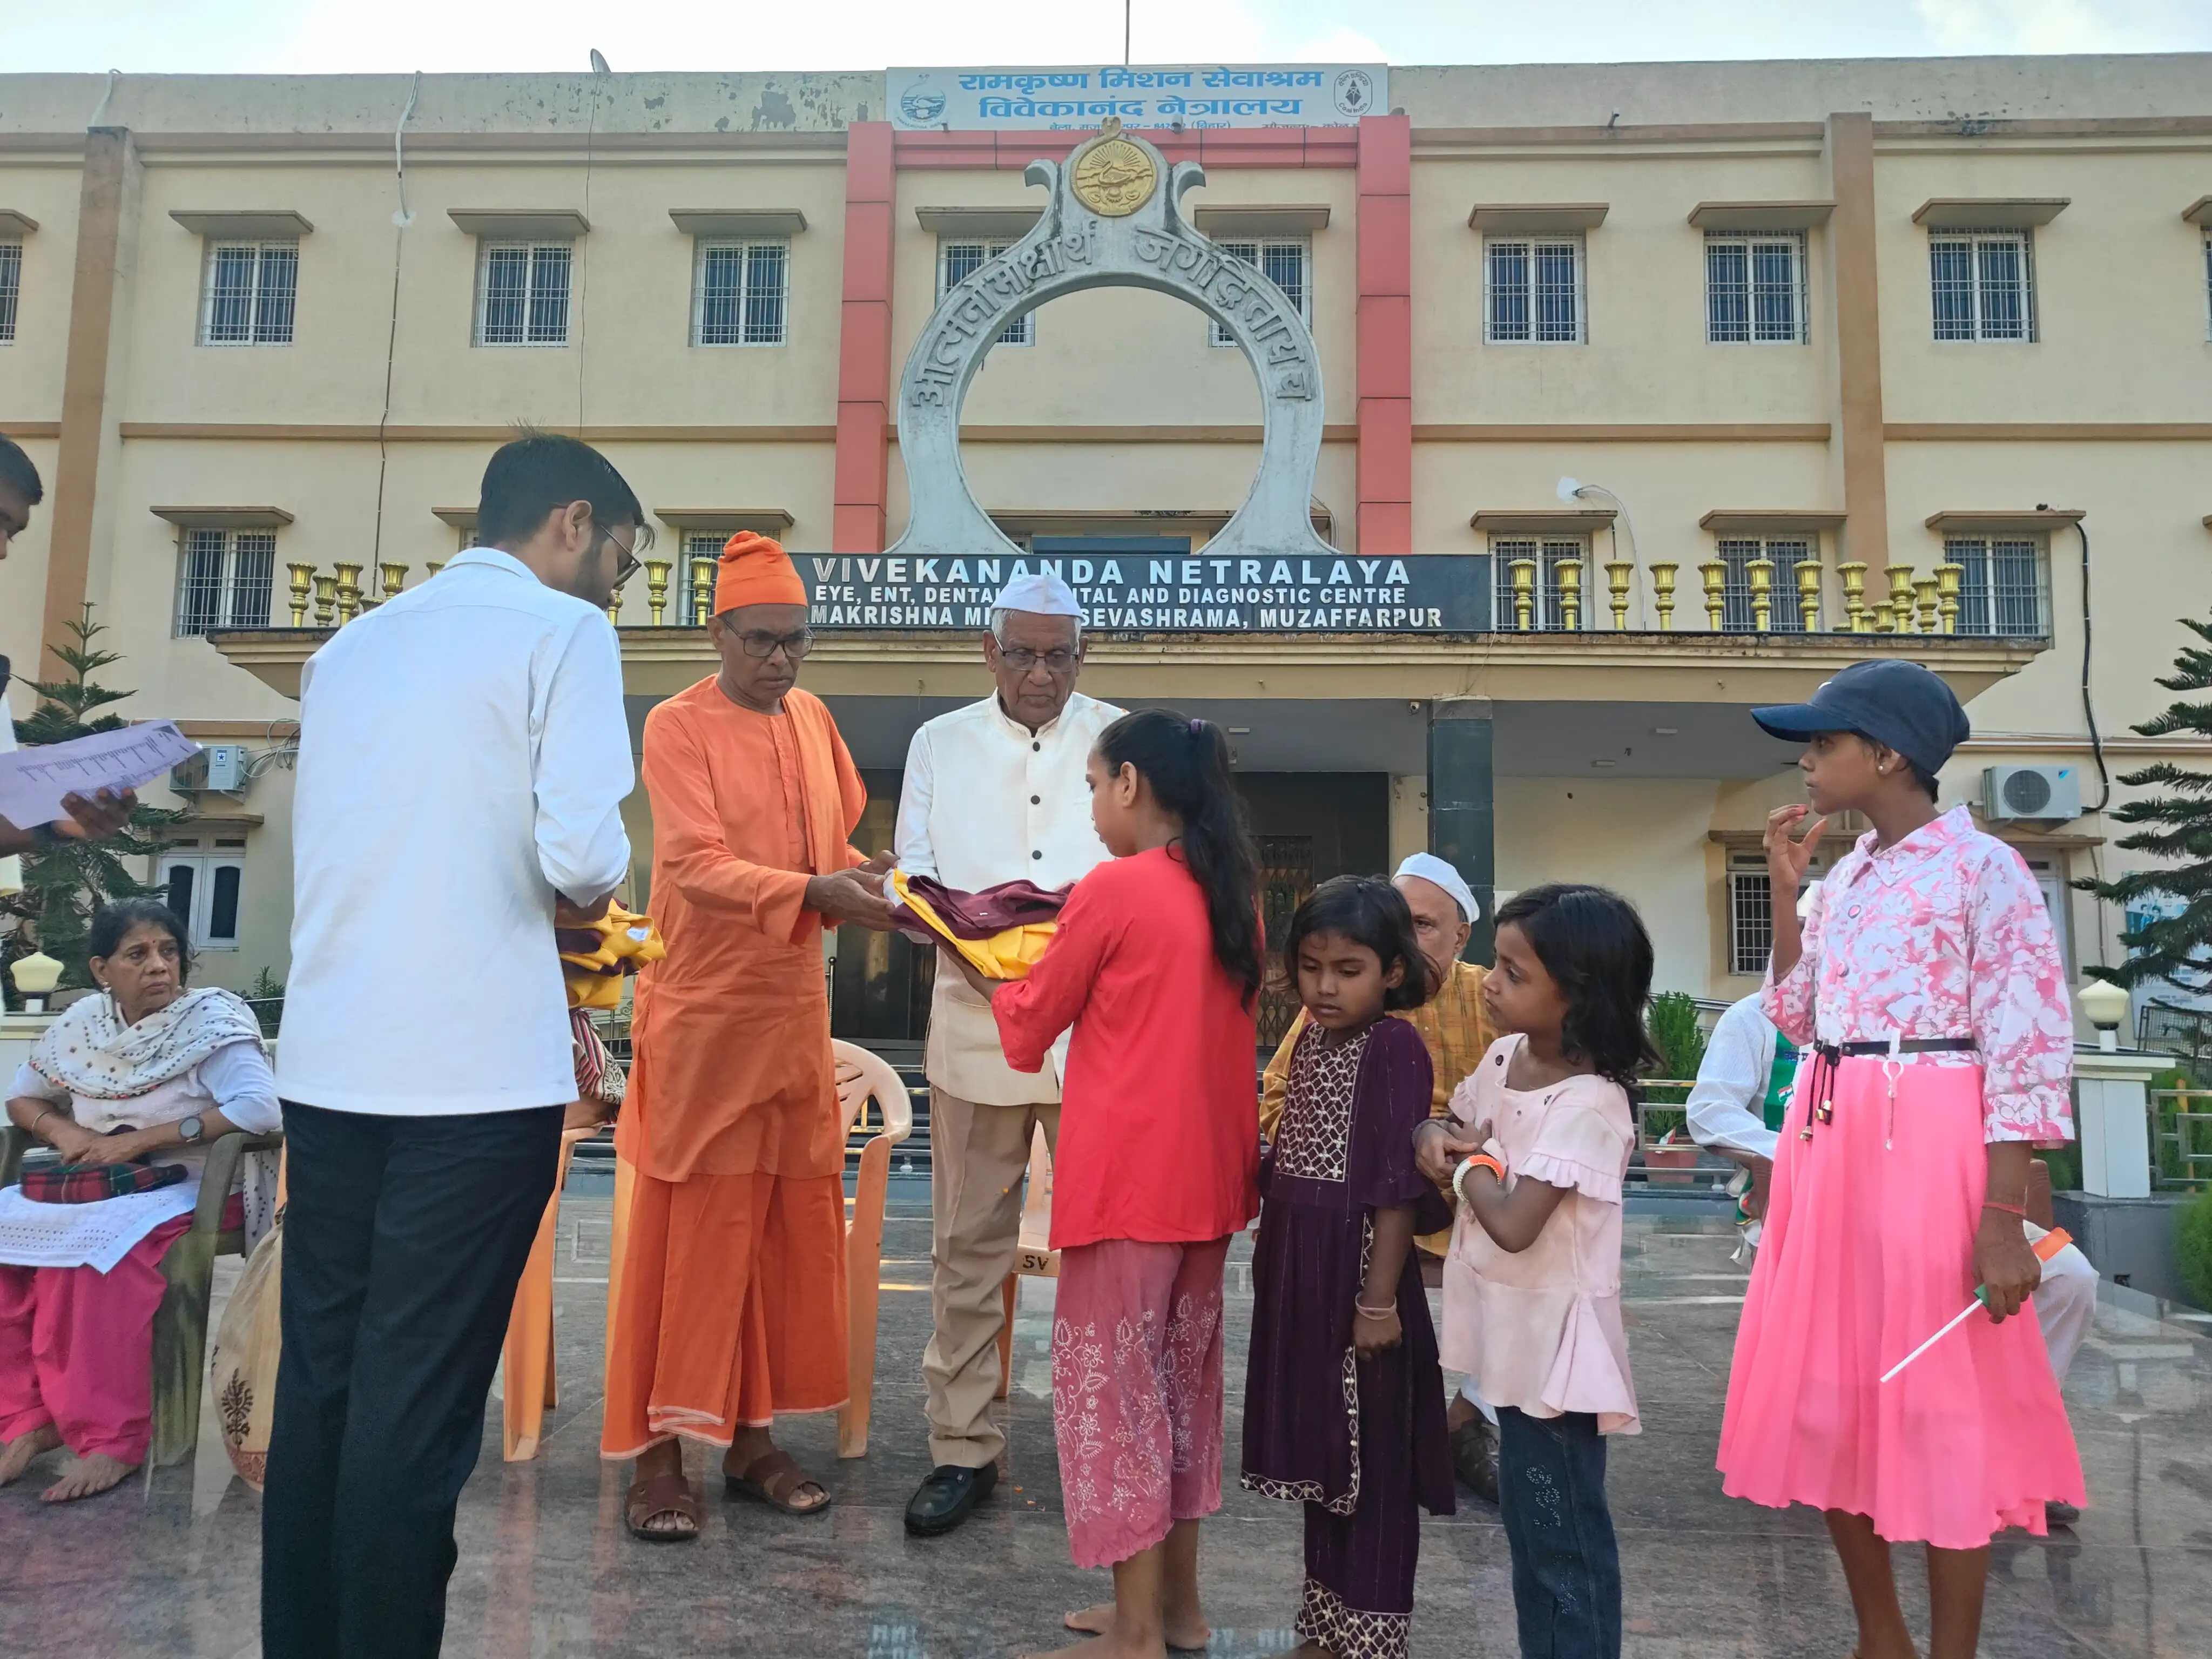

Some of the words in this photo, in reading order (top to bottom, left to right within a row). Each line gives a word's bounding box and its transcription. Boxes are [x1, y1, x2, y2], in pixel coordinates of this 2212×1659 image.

[959, 73, 1090, 95] रामकृष्ण
[1098, 67, 1193, 89] मिशन
[1202, 66, 1324, 87] सेवाश्रम
[979, 96, 1147, 117] विवेकानंद
[1156, 95, 1303, 116] नेत्रालय
[1339, 103, 1352, 113] Coal
[1353, 103, 1368, 113] India
[812, 558, 1124, 584] VIVEKANANDA
[1149, 559, 1411, 585] NETRALAYA
[815, 585, 862, 605] EYE,
[870, 586, 916, 606] ENT,
[1126, 588, 1169, 604] AND
[1178, 587, 1311, 604] DIAGNOSTIC
[1319, 587, 1406, 604] CENTRE
[1081, 608, 1249, 629] SEVASHRAMA,
[1260, 608, 1442, 628] MUZAFFARPUR
